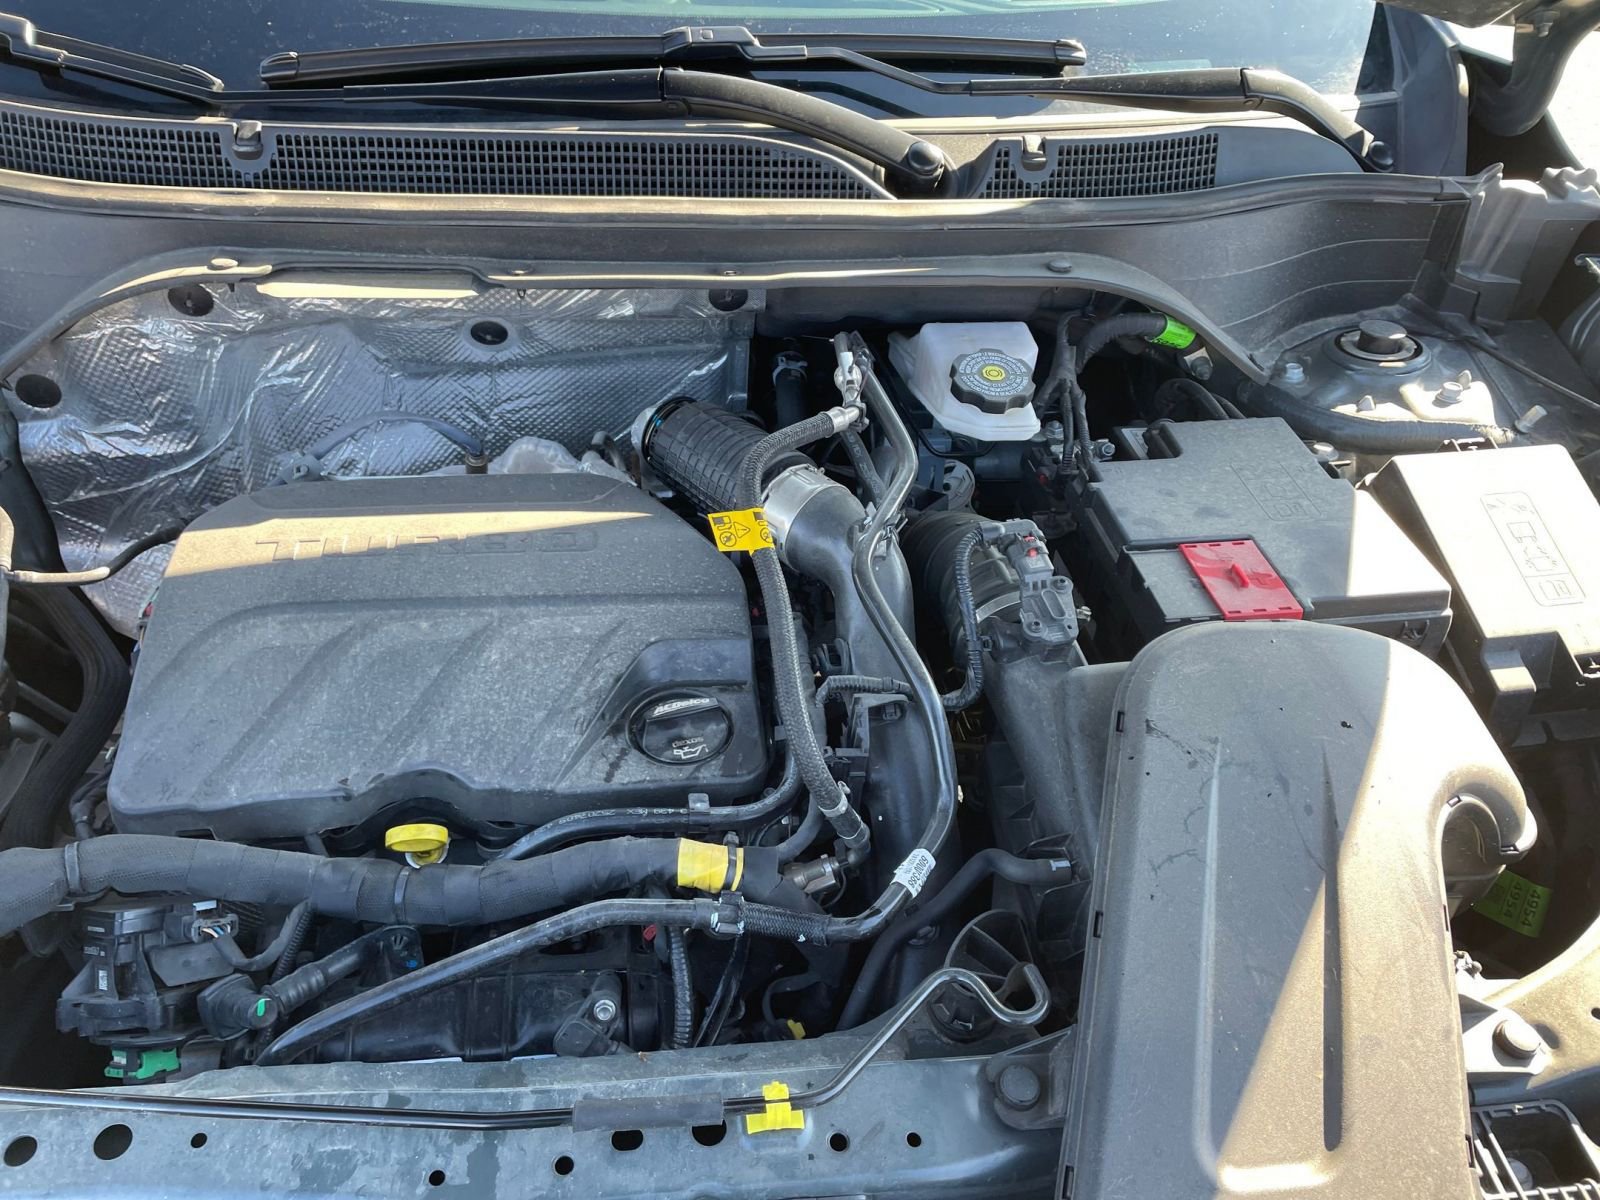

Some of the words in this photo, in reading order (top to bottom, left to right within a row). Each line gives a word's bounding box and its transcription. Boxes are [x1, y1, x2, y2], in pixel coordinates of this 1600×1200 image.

[254, 531, 598, 562] TURBO
[652, 697, 710, 716] ACDelco
[1521, 889, 1541, 928] 4954
